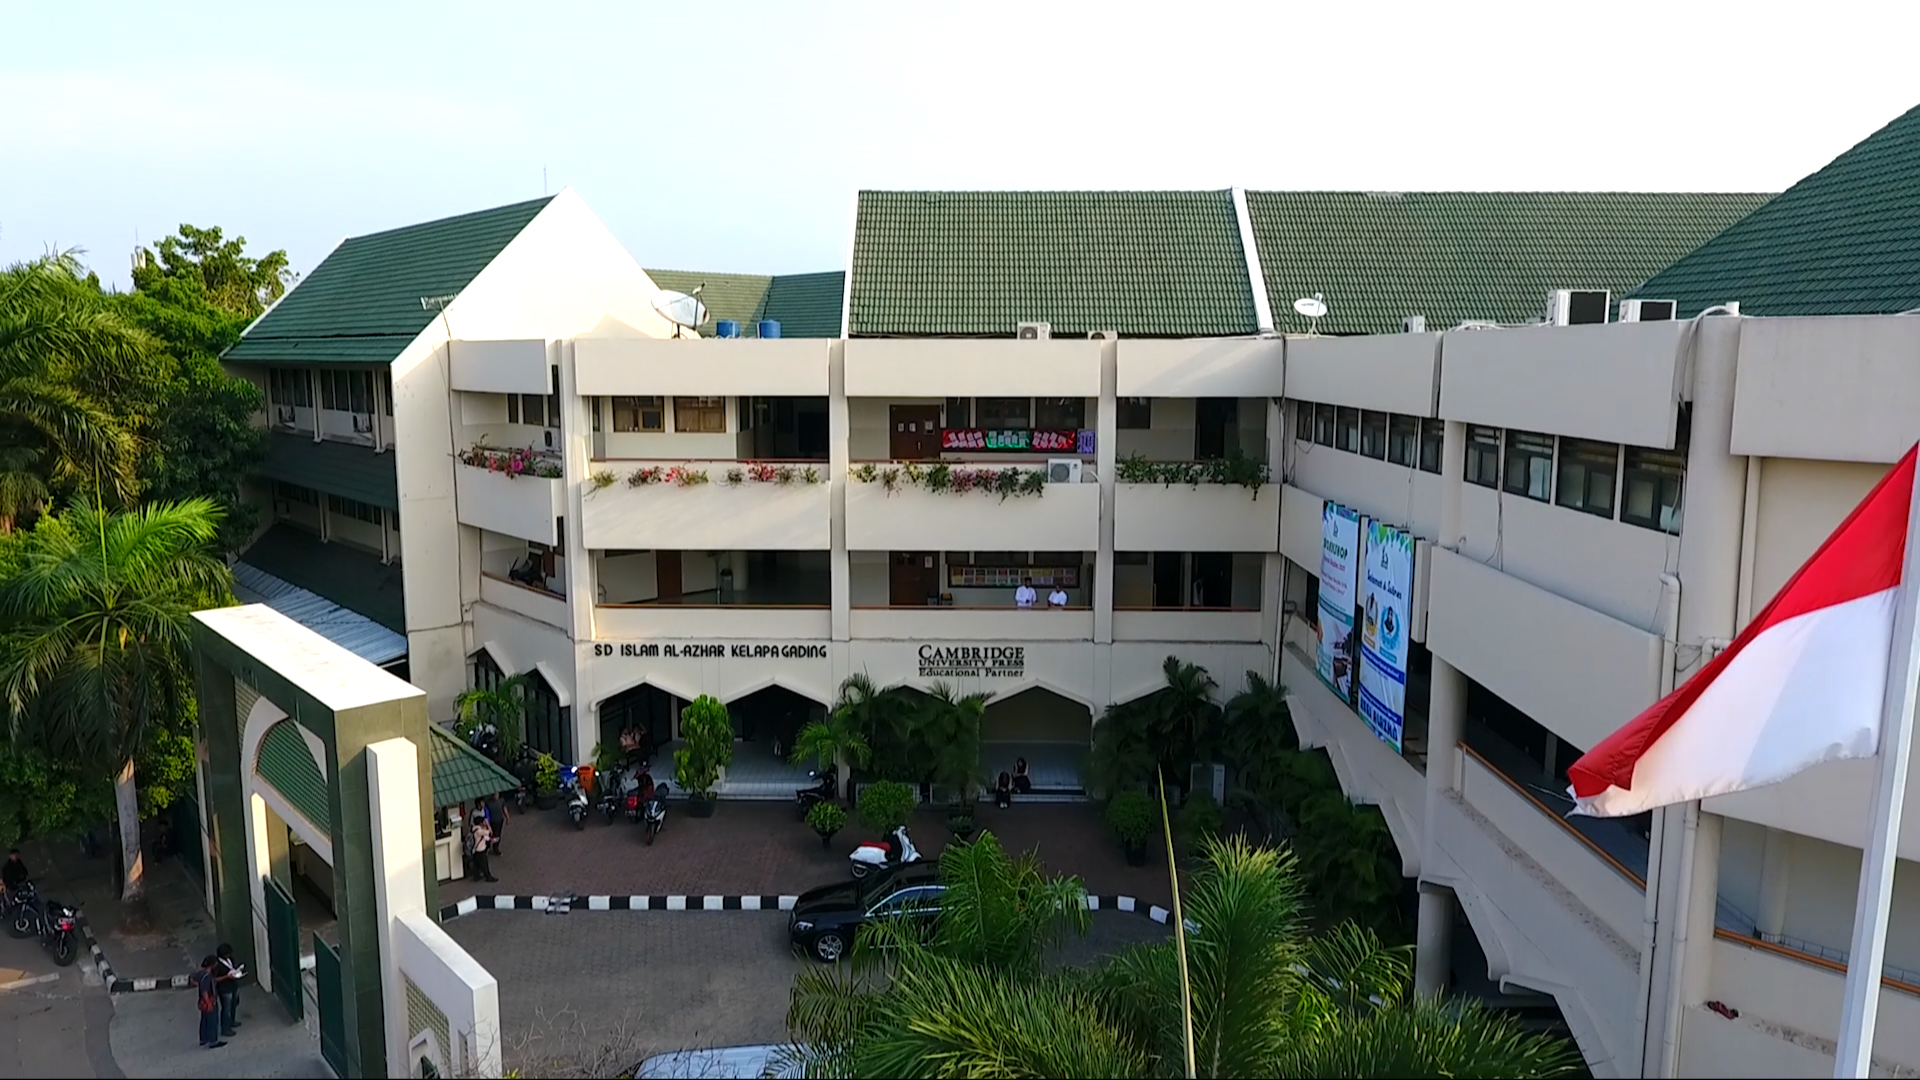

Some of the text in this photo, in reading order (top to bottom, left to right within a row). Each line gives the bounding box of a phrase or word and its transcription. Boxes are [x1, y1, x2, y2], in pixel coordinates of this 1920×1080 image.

[594, 644, 613, 657] SD
[620, 644, 659, 657] ISLAM
[664, 644, 725, 658] AL-AZHAR
[918, 644, 1025, 660] CAMBRIDGE
[919, 659, 1025, 667] UNIVERSITY PRESS
[918, 667, 1025, 677] Educational Partner
